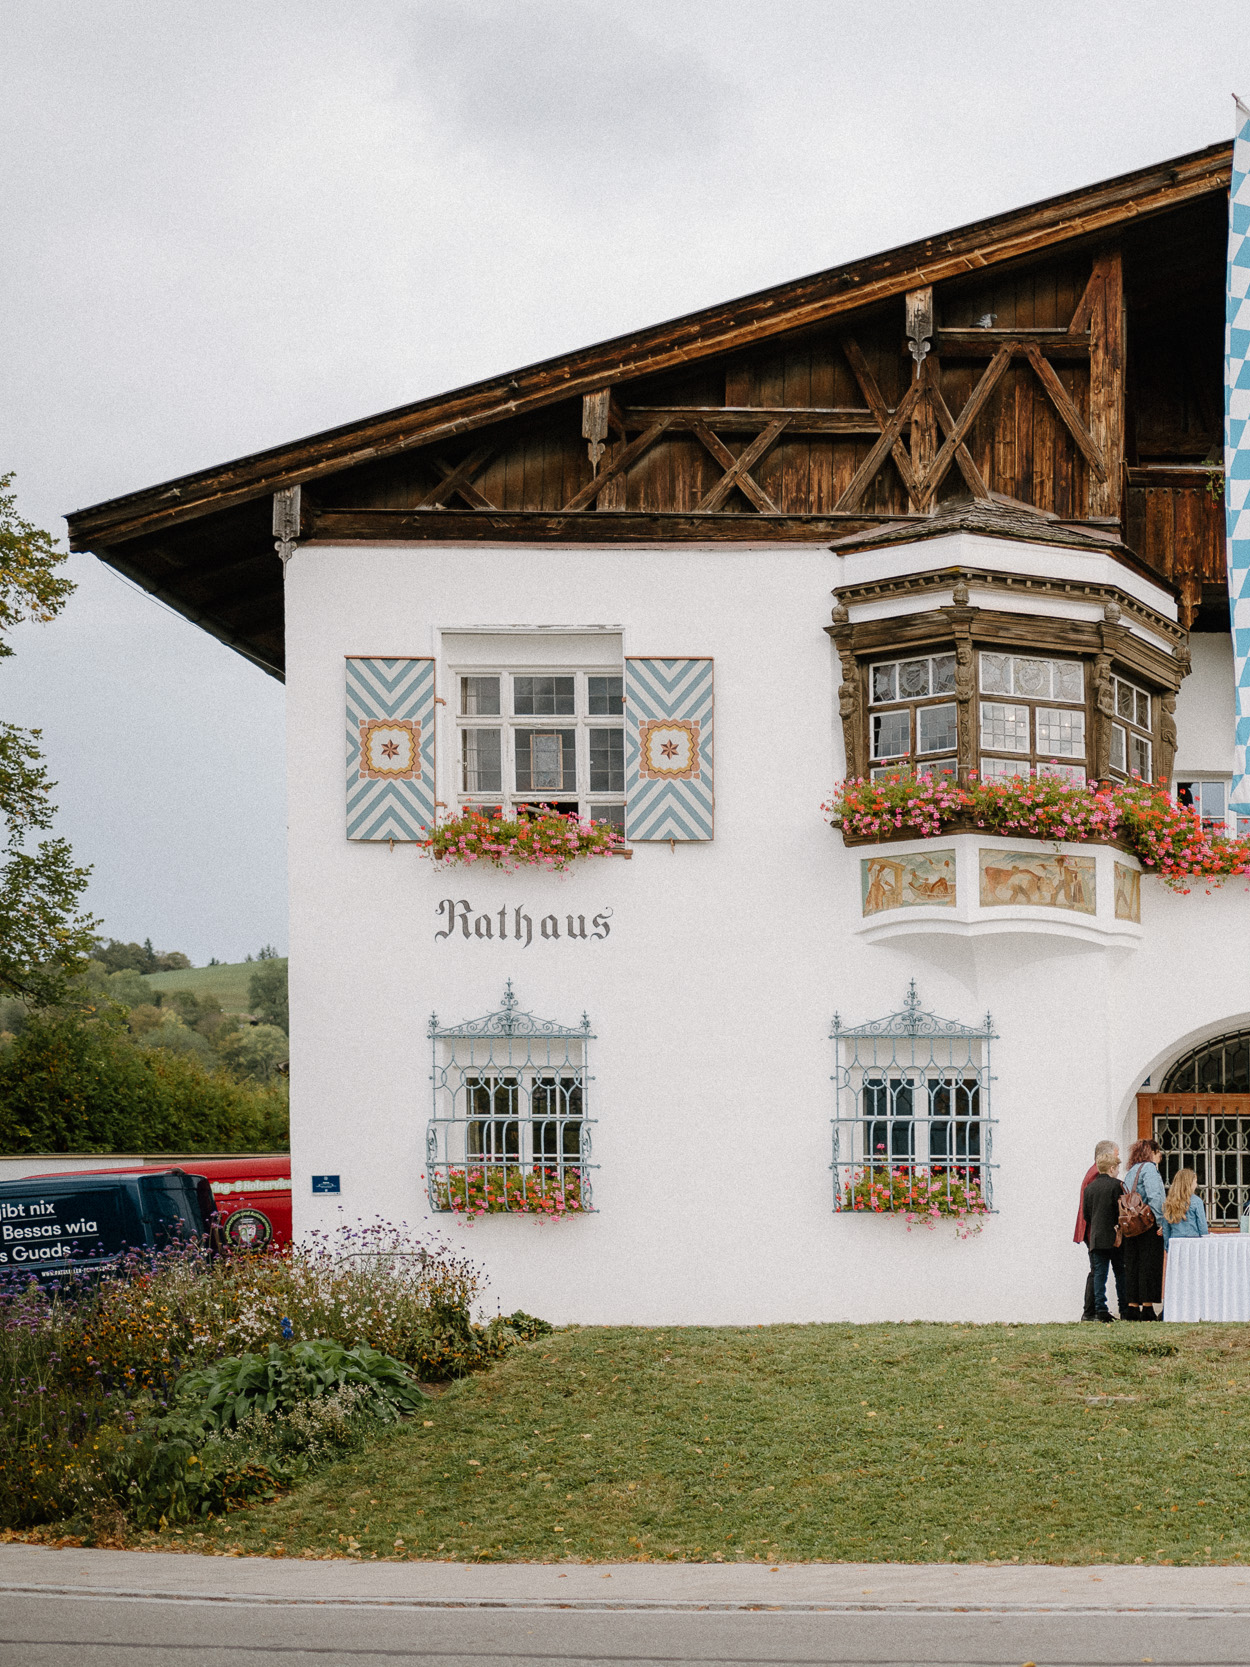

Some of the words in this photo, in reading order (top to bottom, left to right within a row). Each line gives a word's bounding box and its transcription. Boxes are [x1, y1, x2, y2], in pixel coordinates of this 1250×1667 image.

[434, 899, 614, 950] Rathaus
[210, 1181, 234, 1195] ring-
[0, 1203, 26, 1221] ibt
[30, 1200, 55, 1215] nix
[3, 1224, 62, 1240] Bessas
[65, 1218, 98, 1234] wia
[12, 1243, 71, 1261] Guads
